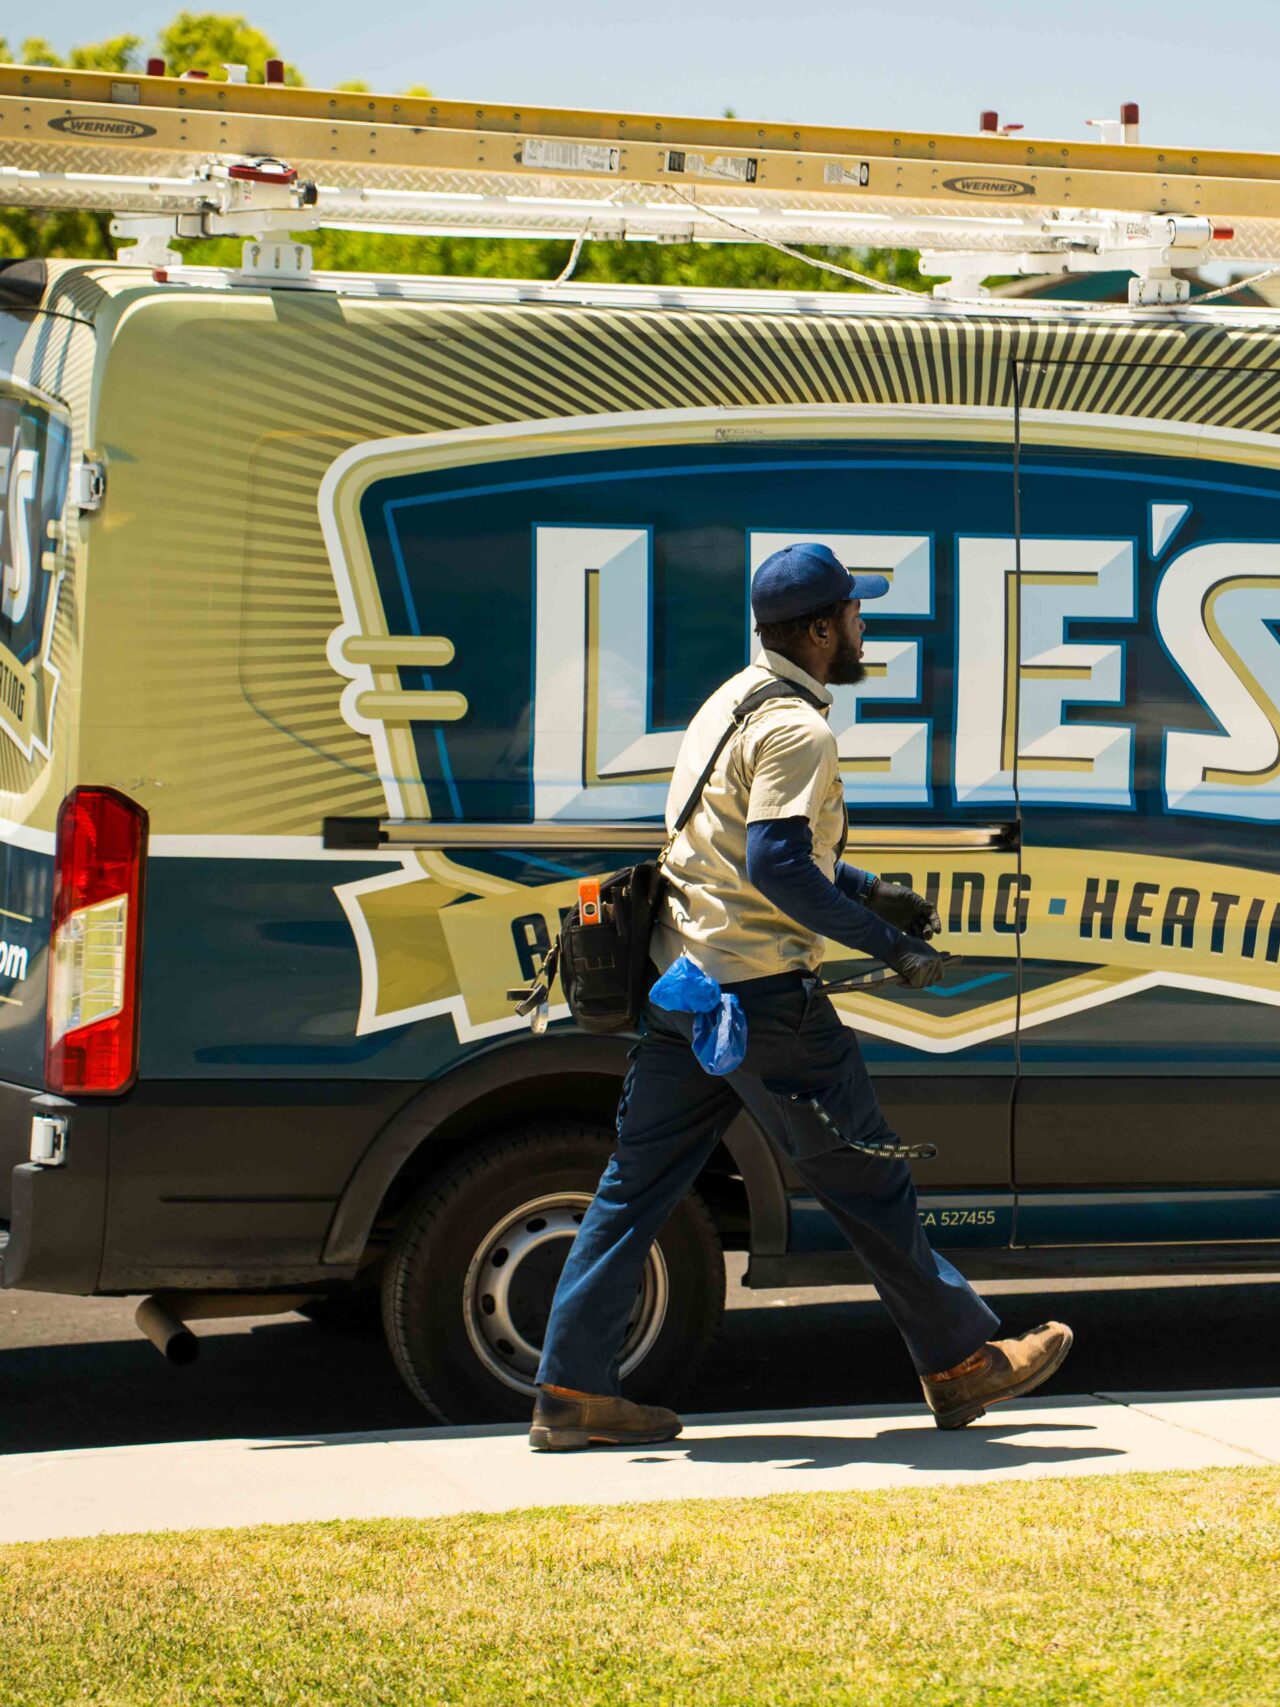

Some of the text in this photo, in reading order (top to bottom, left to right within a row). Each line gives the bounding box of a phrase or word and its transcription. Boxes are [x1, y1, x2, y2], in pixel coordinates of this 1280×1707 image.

[71, 120, 137, 135] WERNER
[961, 180, 1017, 193] WERNER
[940, 1210, 996, 1227] 527455
